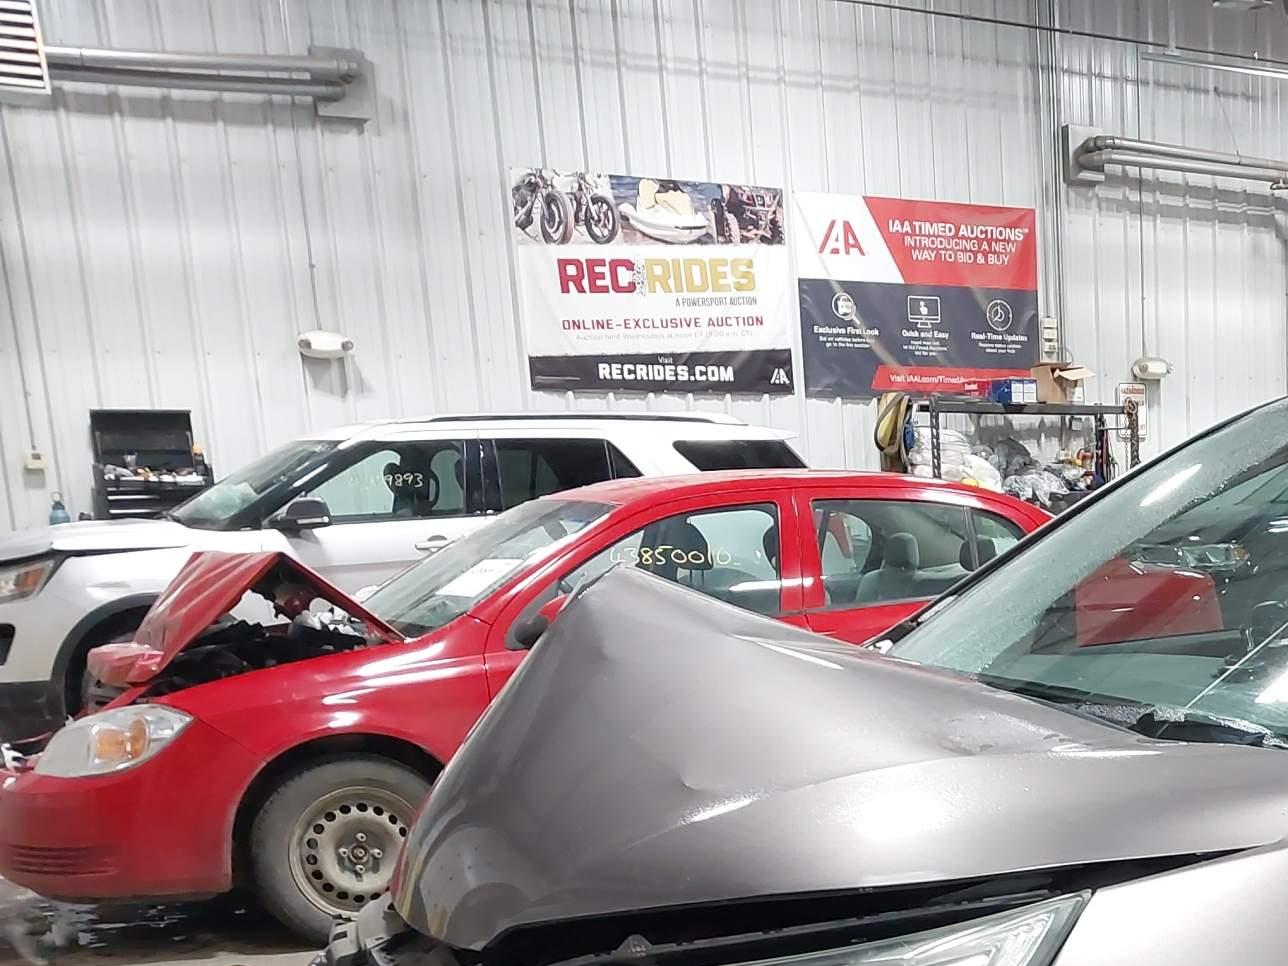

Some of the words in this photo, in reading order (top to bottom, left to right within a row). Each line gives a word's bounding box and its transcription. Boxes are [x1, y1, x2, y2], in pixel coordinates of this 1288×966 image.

[888, 219, 912, 234] IAA
[913, 221, 955, 237] TIMED
[904, 236, 978, 251] INTRODUCING
[981, 241, 989, 251] A
[991, 242, 1016, 253] NEW
[911, 249, 936, 261] WAY
[940, 250, 955, 262] TO
[957, 252, 974, 263] BID
[976, 253, 985, 264] &
[987, 254, 1009, 265] BUY
[557, 258, 637, 294] REC
[644, 258, 756, 293] RIDES
[682, 297, 728, 308] POWERSPORT
[729, 296, 758, 307] AUCTION
[562, 317, 702, 331] ONLINE-EXCLUSIVE
[707, 316, 764, 328] AUCTION
[934, 331, 949, 340] Easy
[598, 363, 735, 383] RECRIDES.COM
